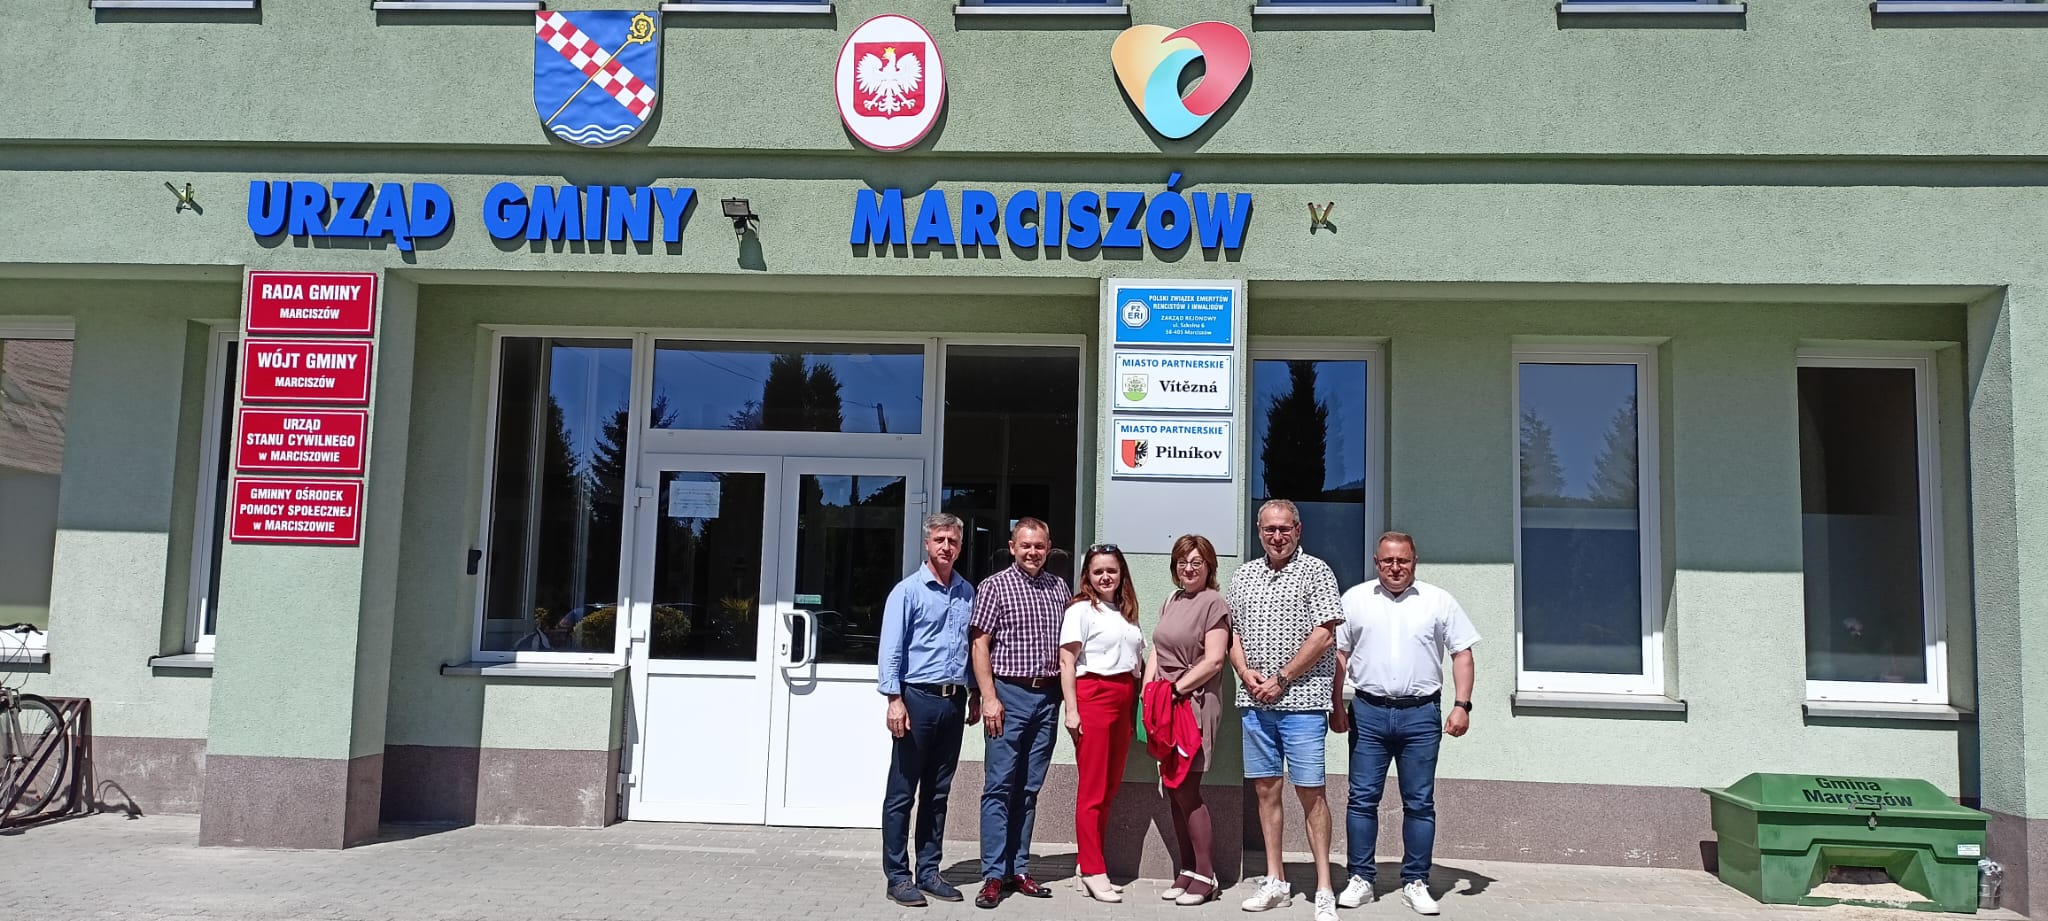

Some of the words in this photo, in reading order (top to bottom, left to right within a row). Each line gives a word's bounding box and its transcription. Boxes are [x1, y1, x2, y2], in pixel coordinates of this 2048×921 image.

[247, 180, 454, 251] URZĄD
[483, 181, 697, 242] GMINY
[850, 172, 1252, 249] MARCISZÓW
[262, 284, 303, 300] RADA
[309, 285, 360, 301] GMINY
[280, 307, 340, 319] MARCISZÓW
[258, 349, 300, 368] WÓJT
[306, 353, 357, 369] GMINY
[1122, 359, 1160, 367] MIASTO
[1162, 360, 1224, 368] PARTNERSKIE
[275, 375, 335, 388] MARCISZÓW
[1160, 380, 1218, 393] Vítězná
[284, 418, 321, 434] URZĄD
[1121, 425, 1157, 433] MIASTO
[1159, 425, 1223, 434] PARTNERSKIE
[246, 433, 284, 446] STANU
[288, 435, 355, 447] CYWILNEGO
[259, 453, 267, 461] w
[271, 450, 340, 462] MARCISZOWIE
[1155, 446, 1222, 459] Pilníkov
[250, 488, 291, 500] GMINNY
[295, 486, 343, 501] OŚRODEK
[240, 504, 284, 516] POMOCY
[288, 505, 352, 518] SPOŁECZNEJ
[253, 522, 261, 530] w
[265, 520, 335, 532] MARCISZOWIE
[1816, 778, 1882, 791] Gmina
[1802, 789, 1912, 806] Marciszów
